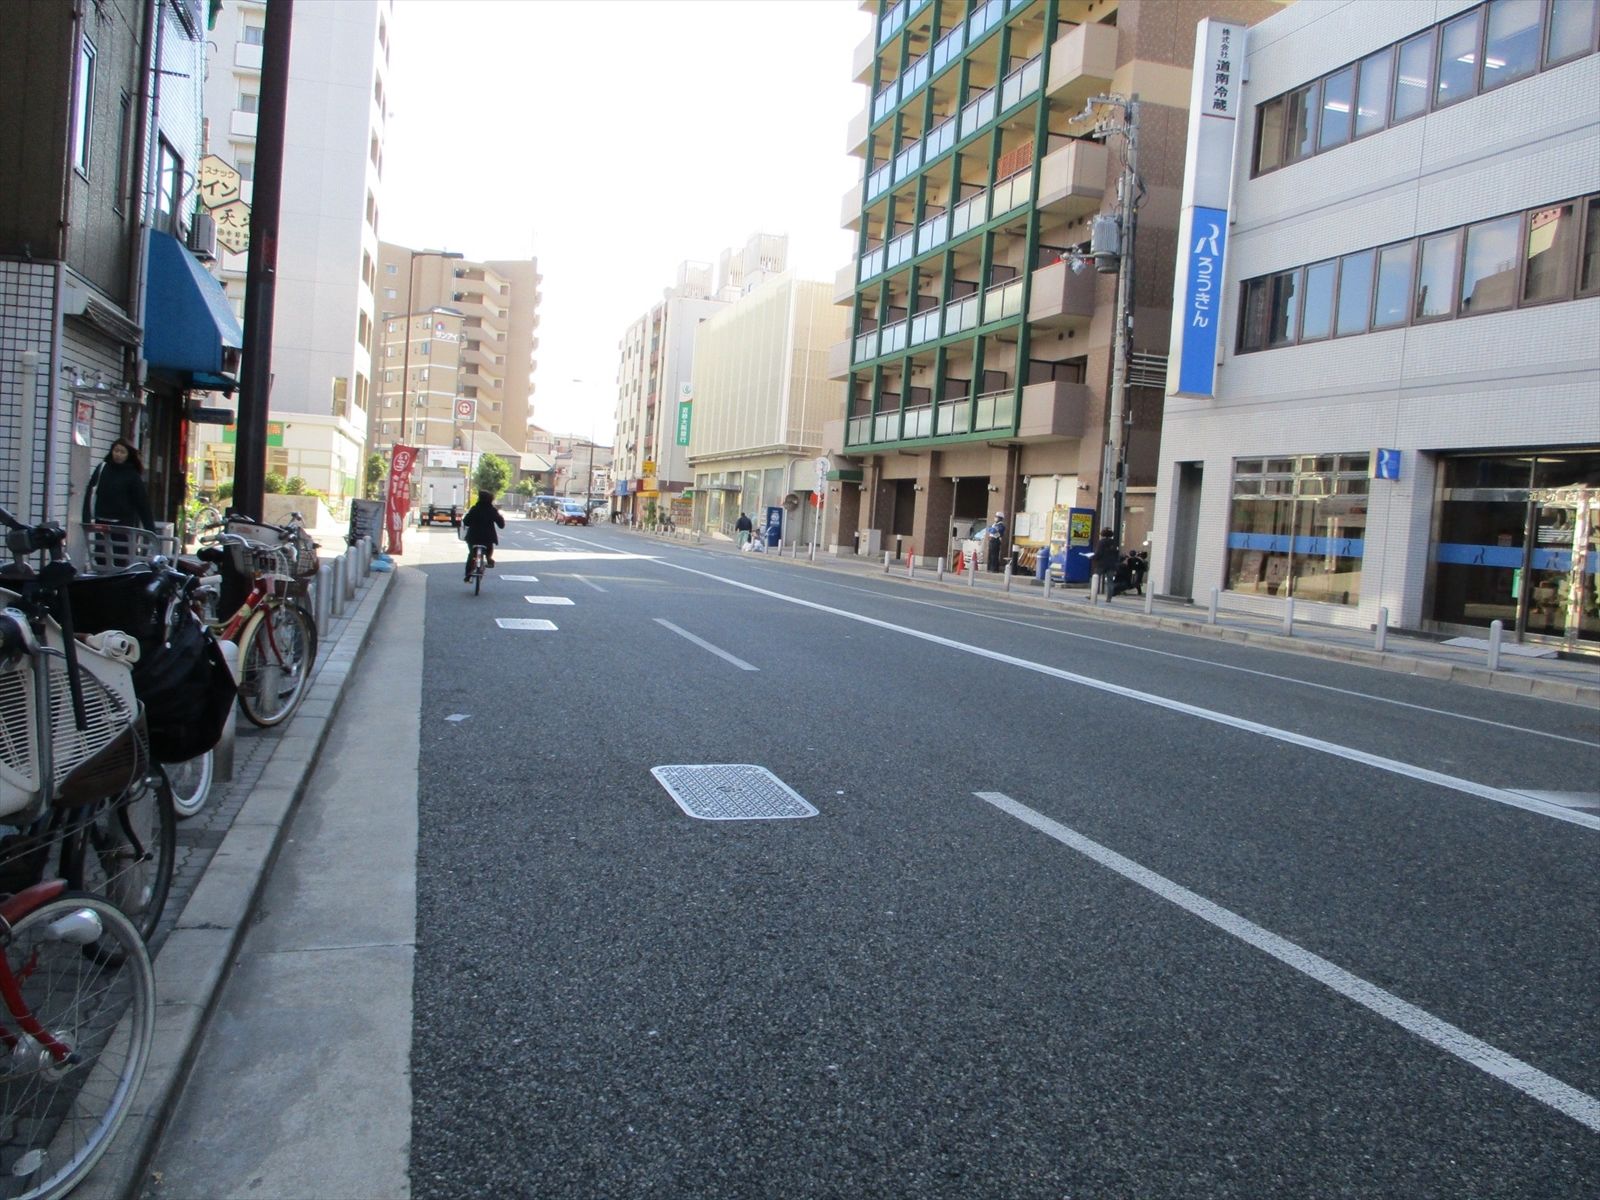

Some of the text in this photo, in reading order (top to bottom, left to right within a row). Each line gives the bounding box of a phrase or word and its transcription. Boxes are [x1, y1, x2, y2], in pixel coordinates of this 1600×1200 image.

[1221, 28, 1230, 58] 株式会社
[1212, 60, 1230, 111] 道南冷蔵
[205, 166, 235, 178] スナック
[1193, 257, 1213, 327] ろうきん
